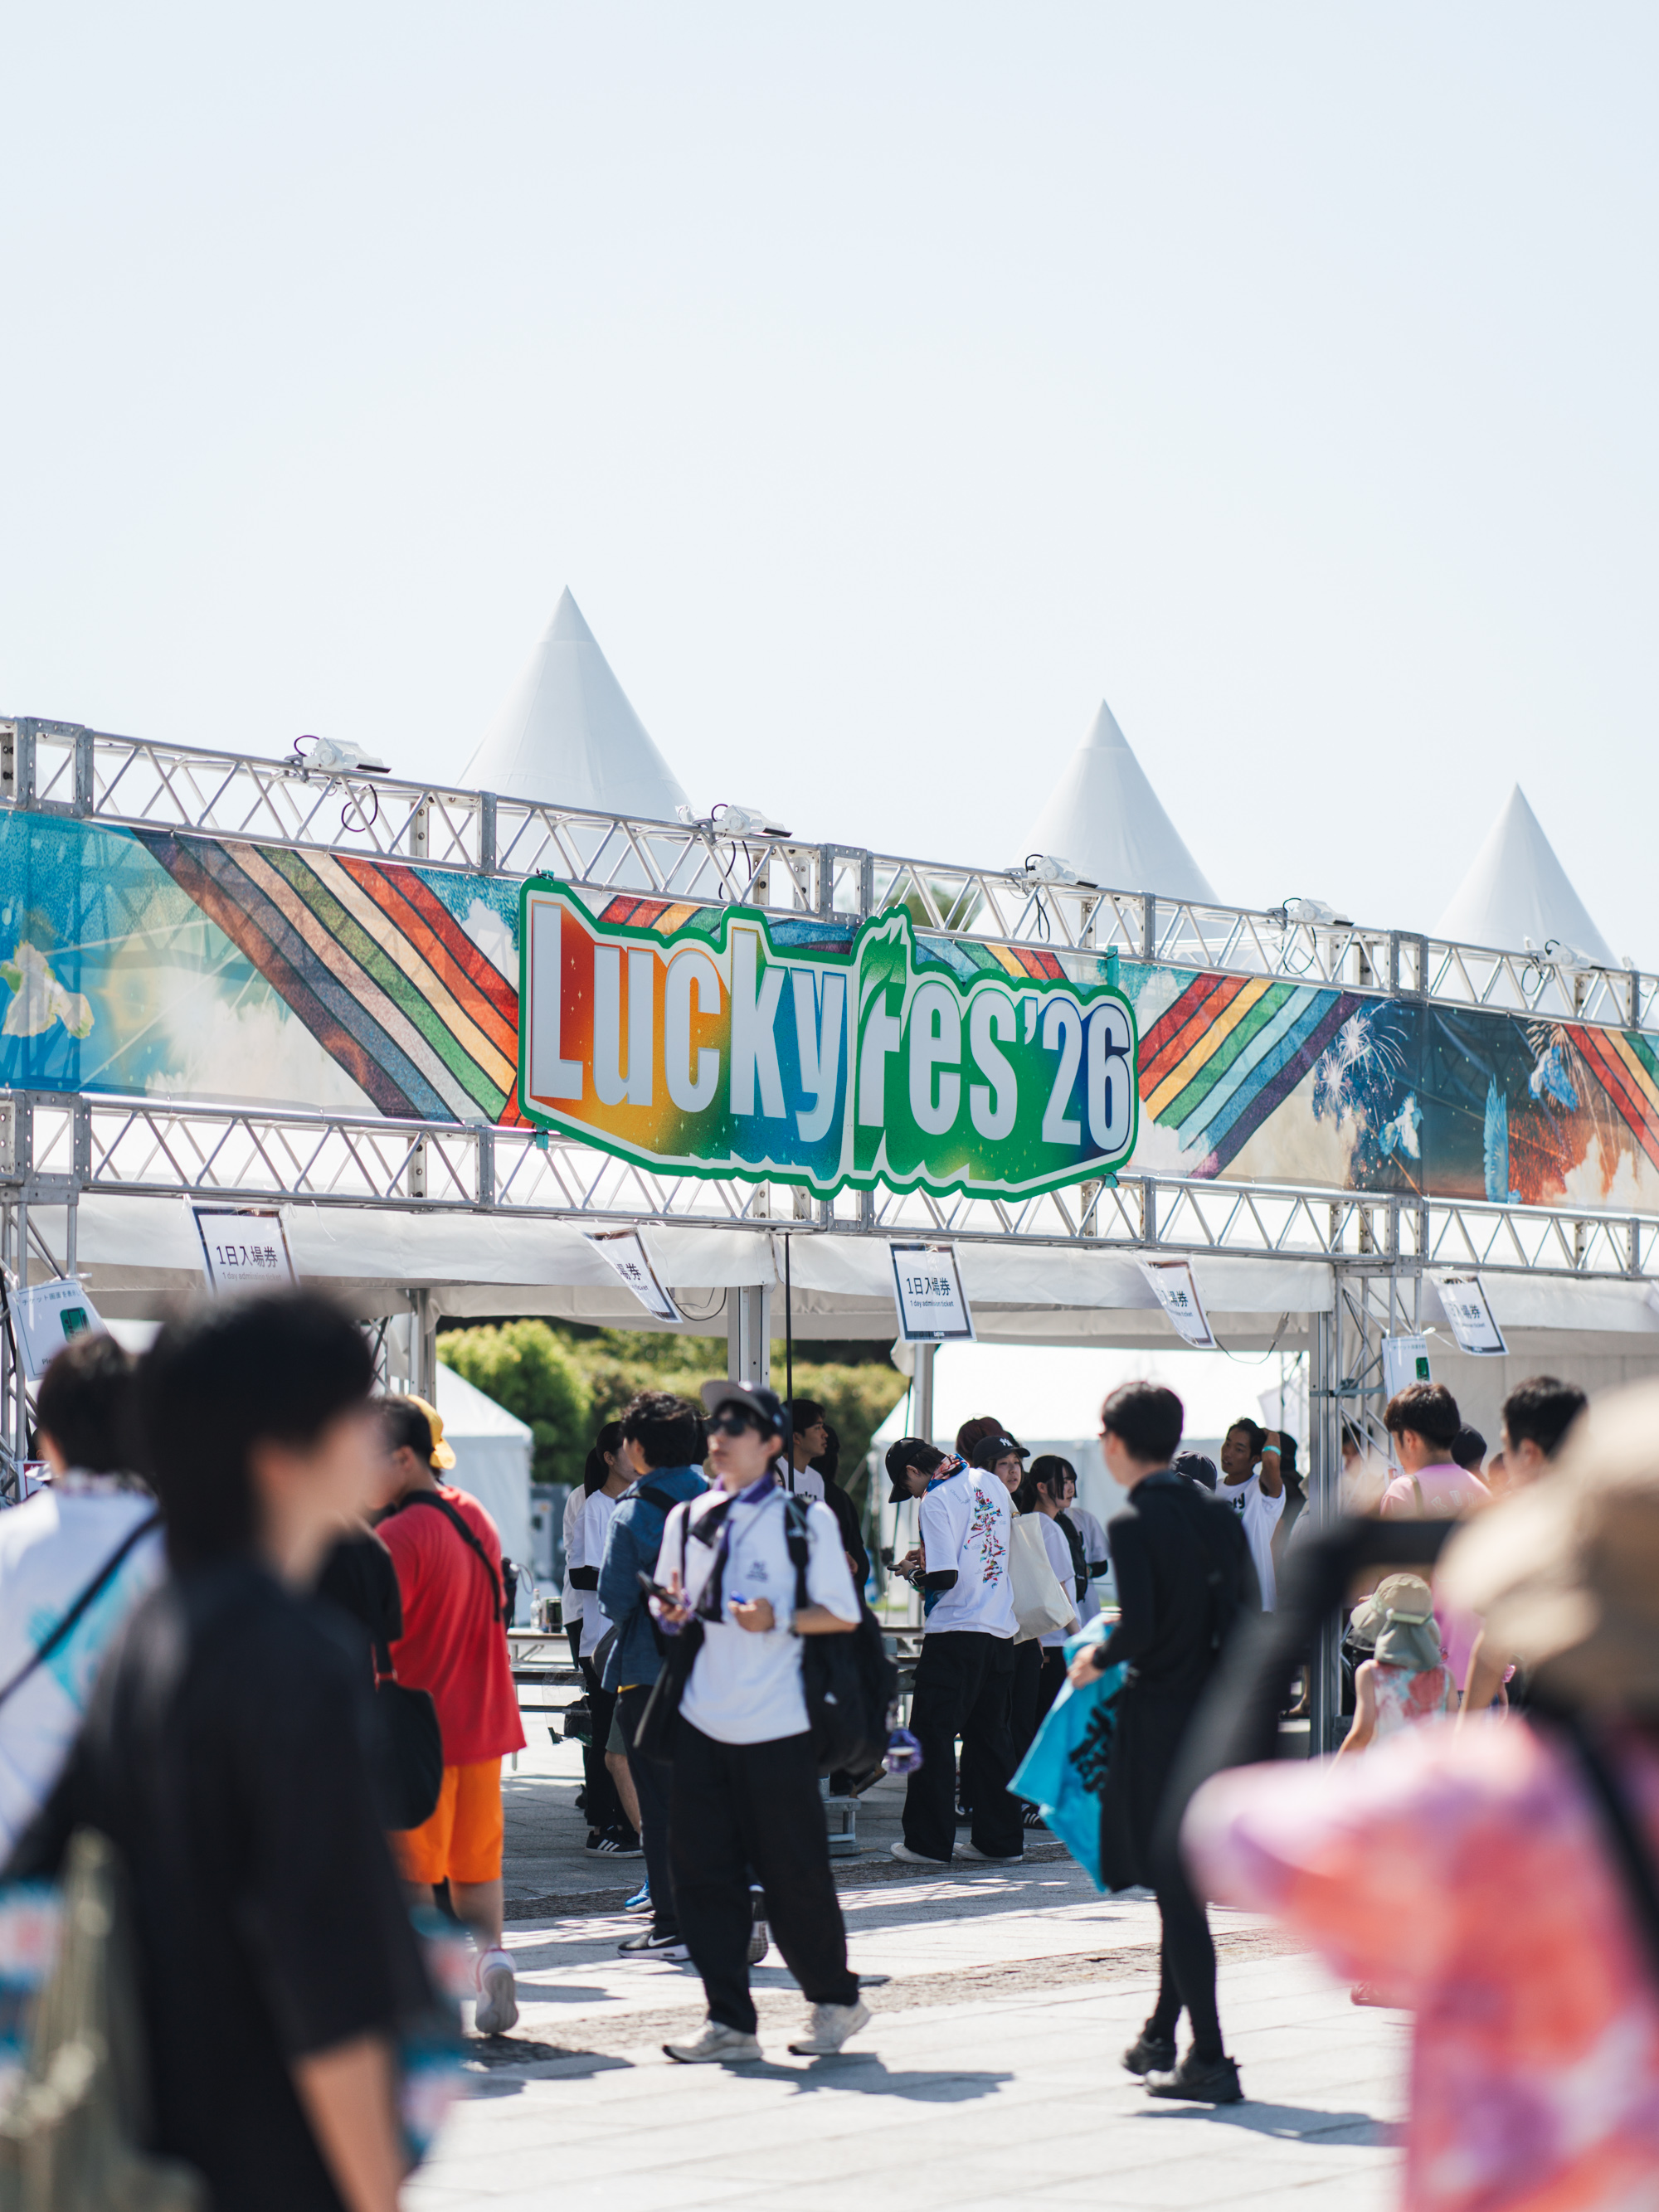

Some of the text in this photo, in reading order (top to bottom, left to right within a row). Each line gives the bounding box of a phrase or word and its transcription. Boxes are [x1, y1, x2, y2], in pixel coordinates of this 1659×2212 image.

[216, 1245, 278, 1267] 1日入場券
[906, 1277, 951, 1296] 1日入場券
[913, 1300, 922, 1309] day
